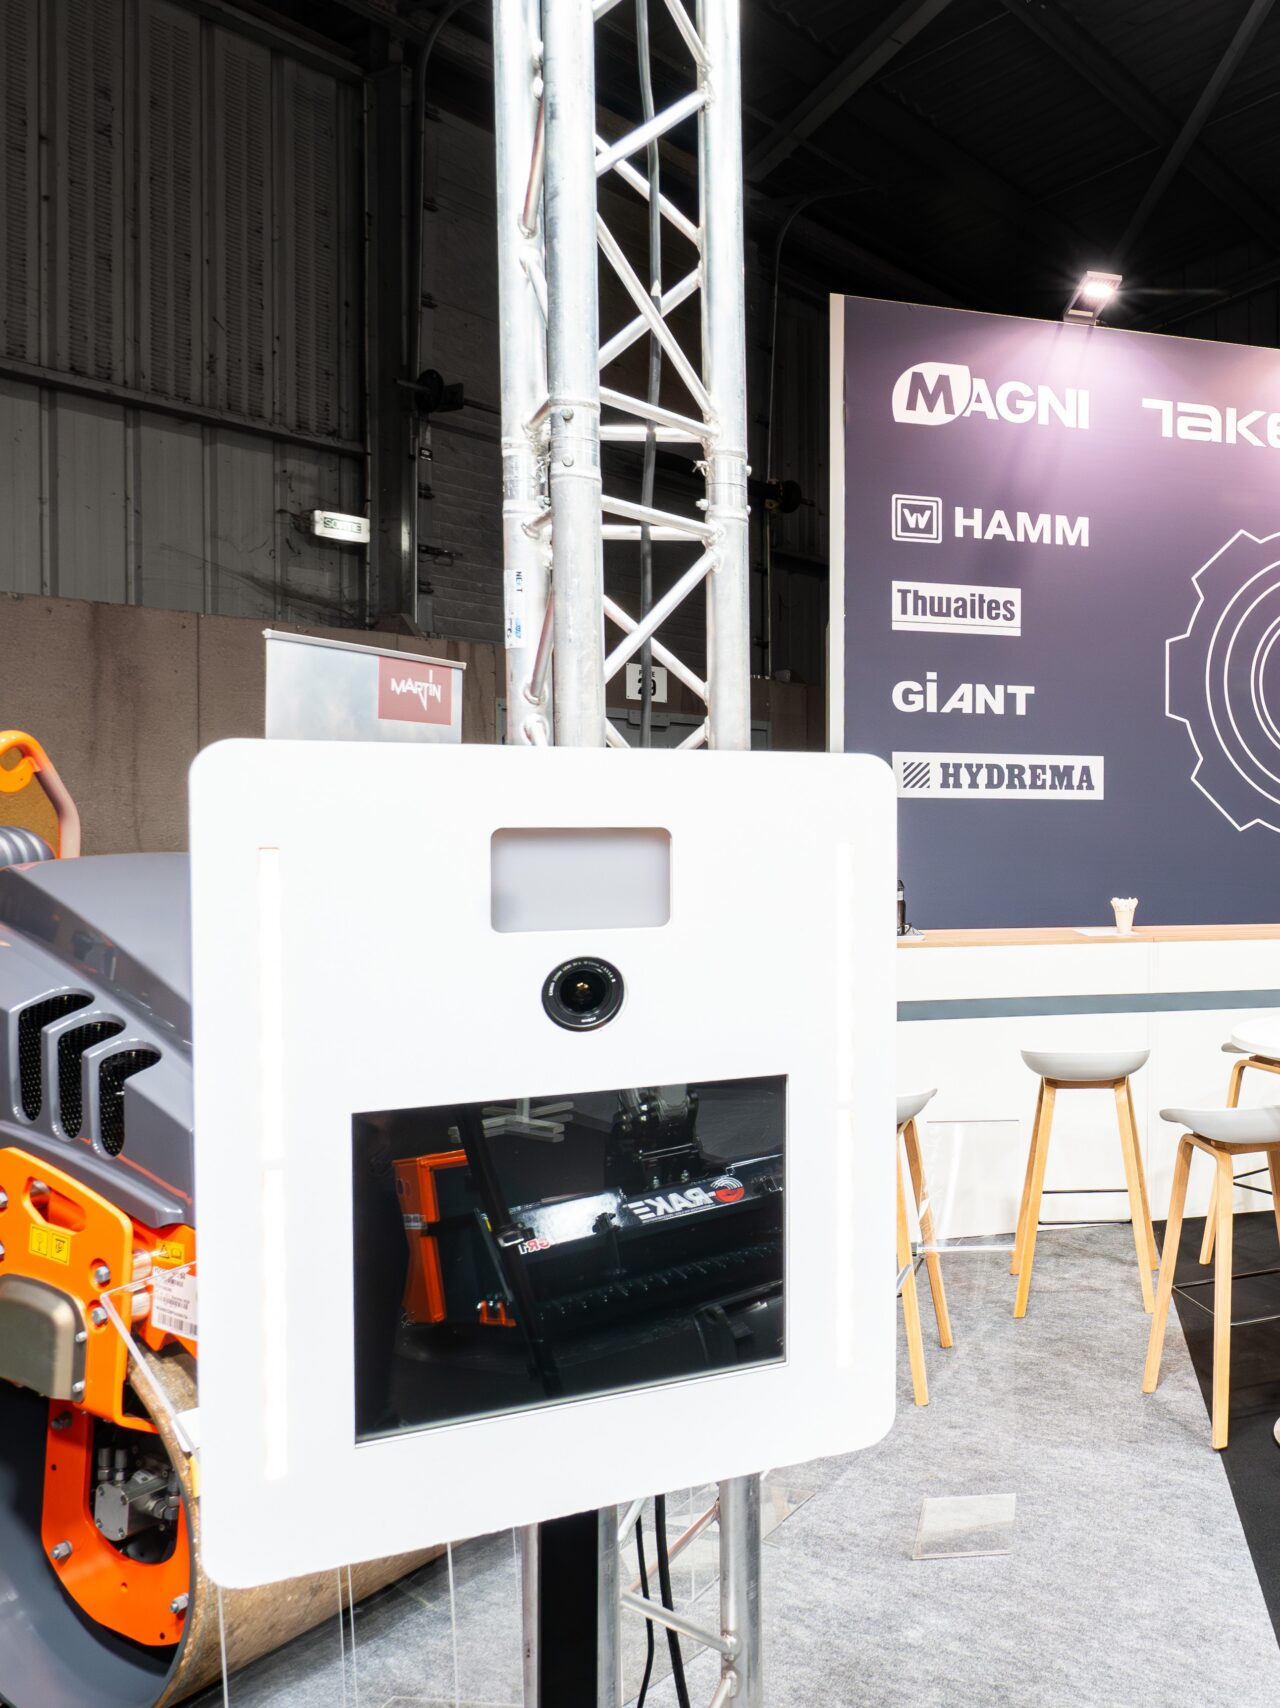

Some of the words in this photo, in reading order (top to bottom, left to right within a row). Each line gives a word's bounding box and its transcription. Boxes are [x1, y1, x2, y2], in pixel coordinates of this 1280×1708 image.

[905, 370, 1090, 430] MAGNI
[953, 506, 1090, 547] HAMM
[897, 588, 1016, 622] Thwaites
[390, 669, 442, 711] MARTIN
[939, 762, 1095, 791] HYDREMA
